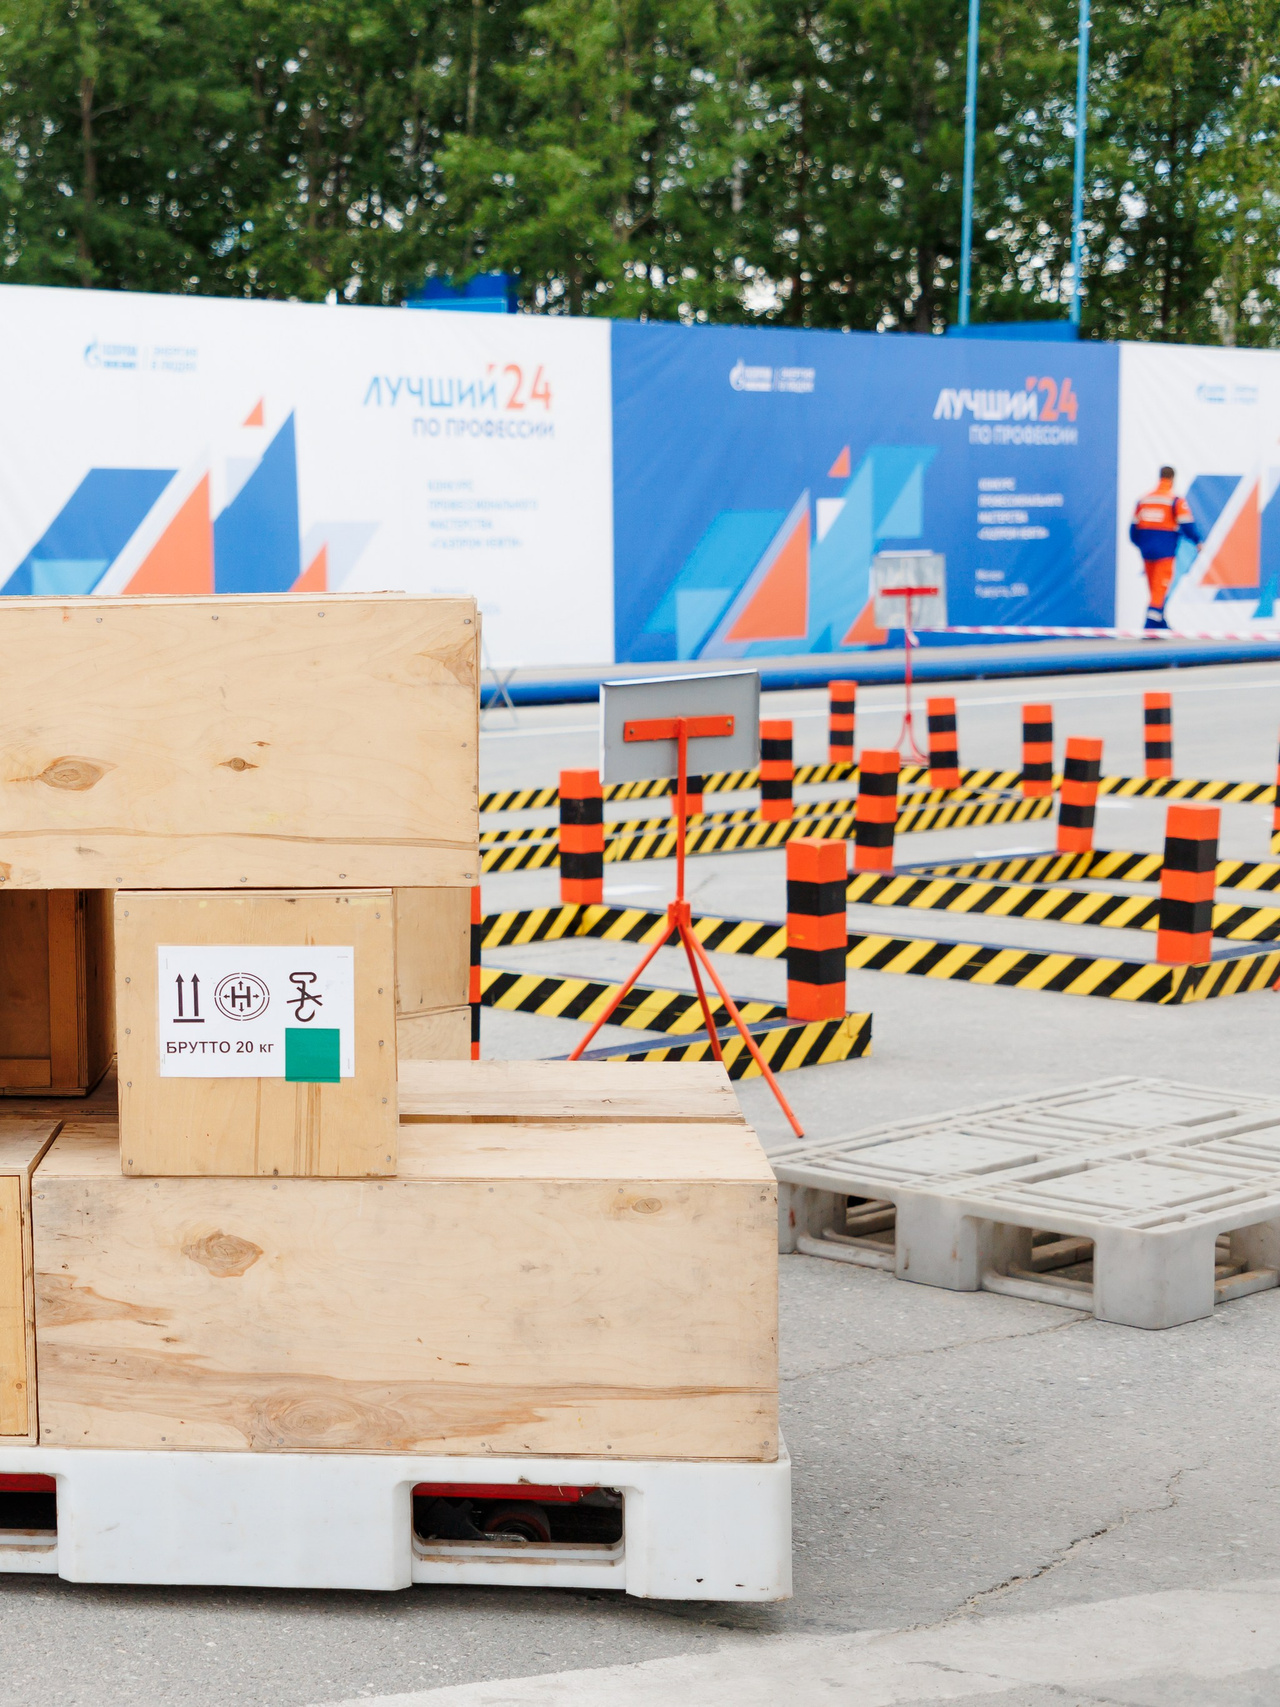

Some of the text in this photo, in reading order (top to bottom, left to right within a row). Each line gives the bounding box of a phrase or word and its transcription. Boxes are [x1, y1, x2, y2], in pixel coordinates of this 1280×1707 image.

[412, 417, 555, 440] ПО ПРОФЕССИИ
[969, 424, 992, 445] ПО
[166, 1040, 274, 1054] БРУТТО 20 кг
